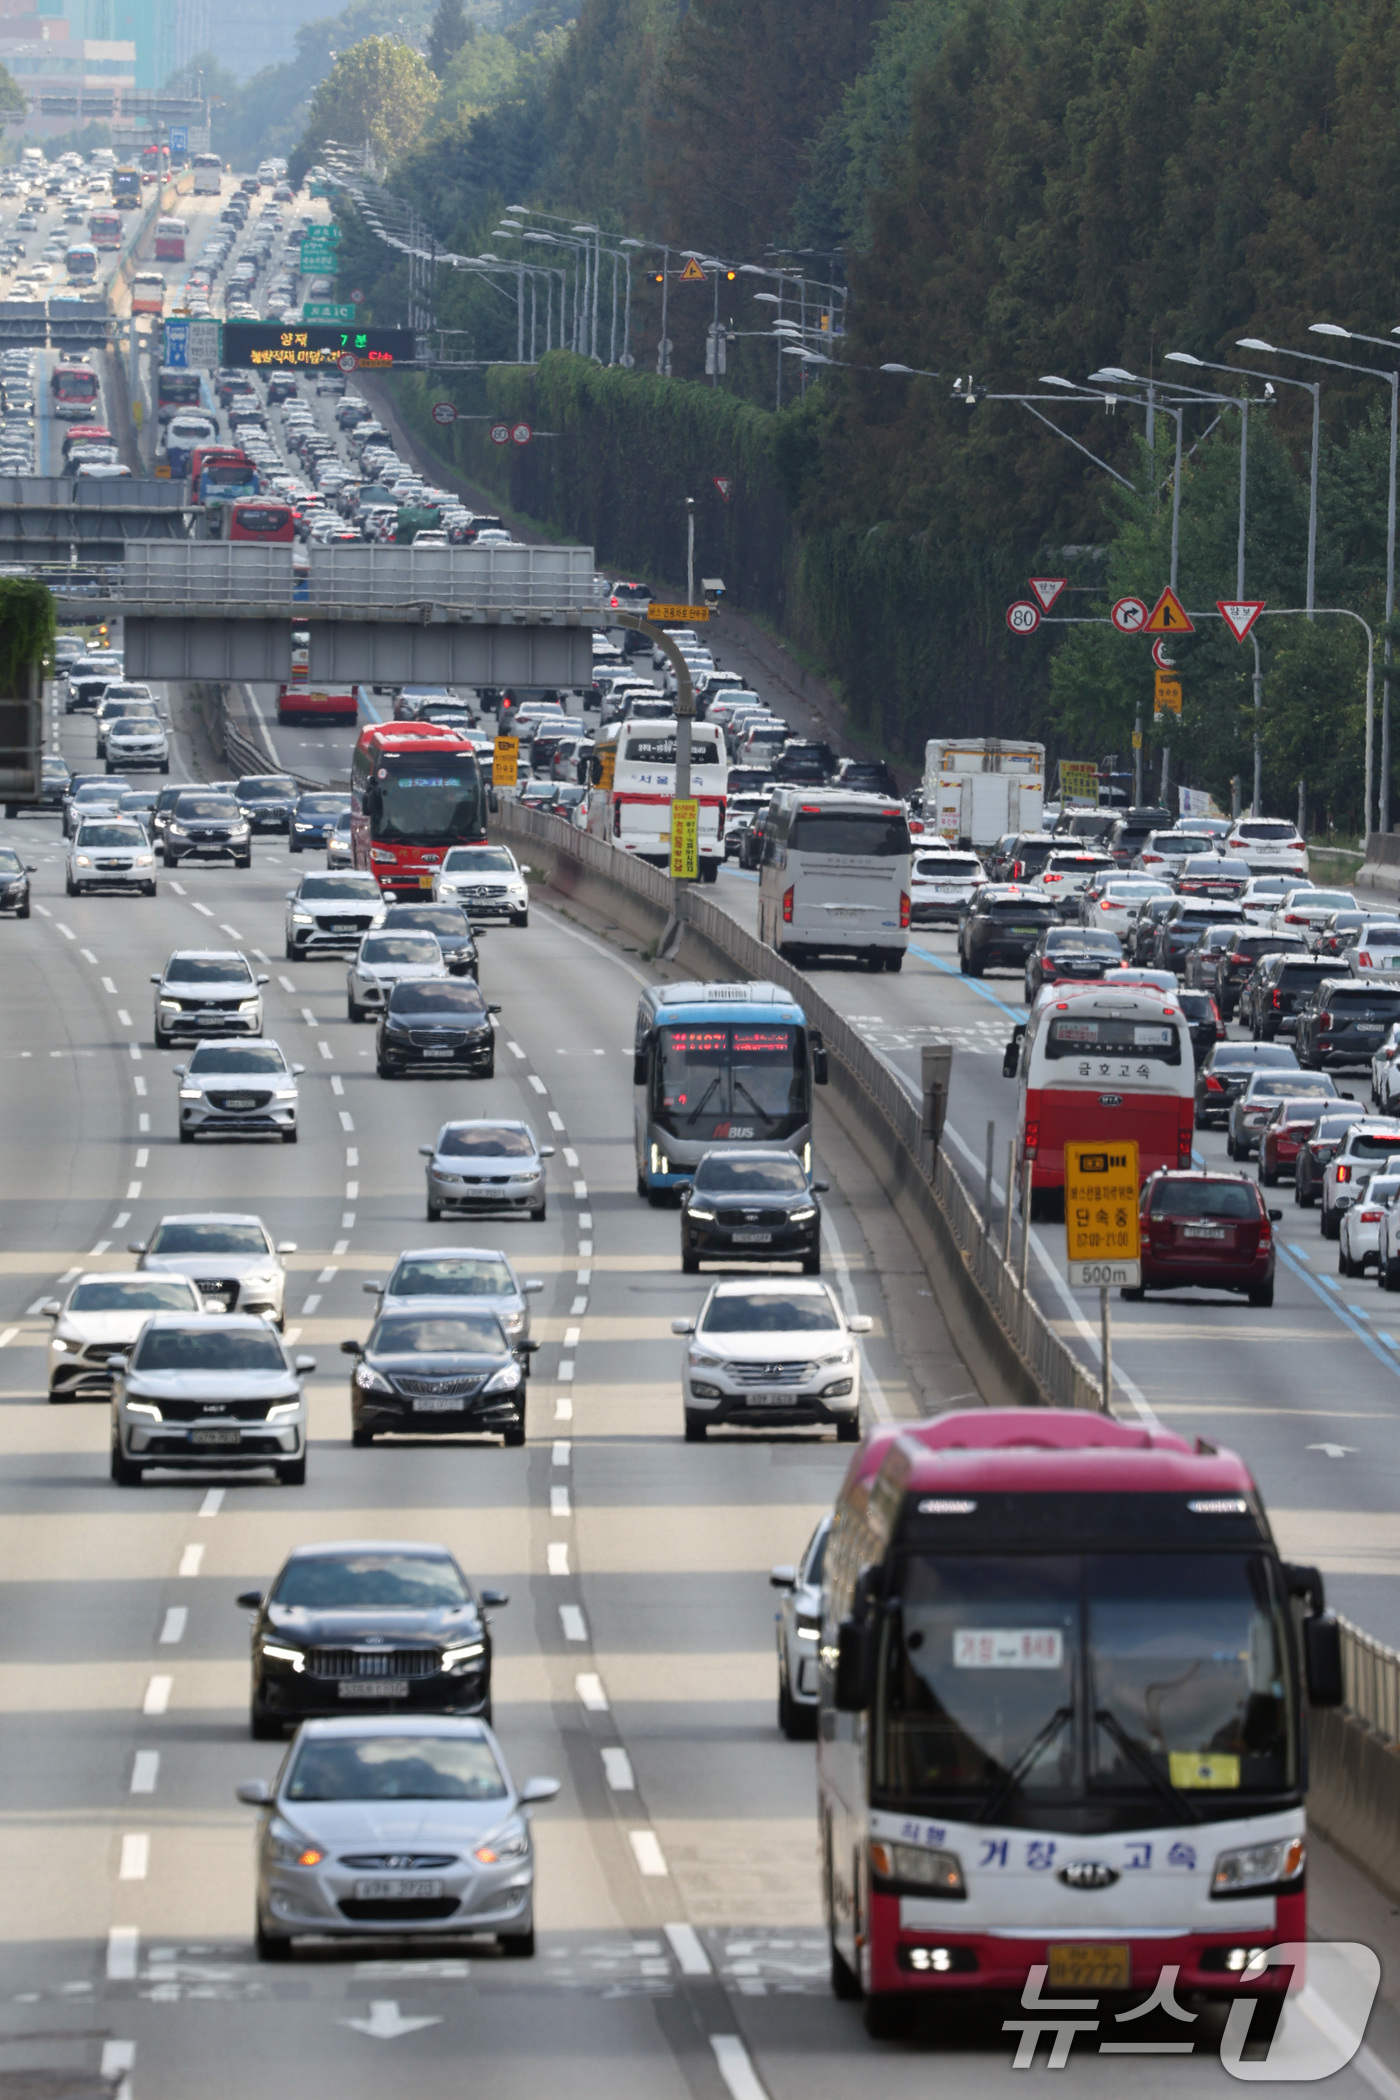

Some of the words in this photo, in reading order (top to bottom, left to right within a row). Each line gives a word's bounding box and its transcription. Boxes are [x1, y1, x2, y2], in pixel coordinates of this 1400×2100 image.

[280, 332, 308, 347] 양재
[341, 334, 348, 346] 7
[354, 333, 367, 348] 분
[1013, 610, 1034, 626] 80
[1230, 606, 1251, 616] 양보
[638, 774, 704, 787] 서울속
[1078, 1061, 1151, 1080] 금호고속
[1082, 1266, 1127, 1283] 500m
[979, 1839, 1057, 1870] 거창
[1123, 1842, 1198, 1870] 고속
[1066, 1864, 1111, 1886] KIA
